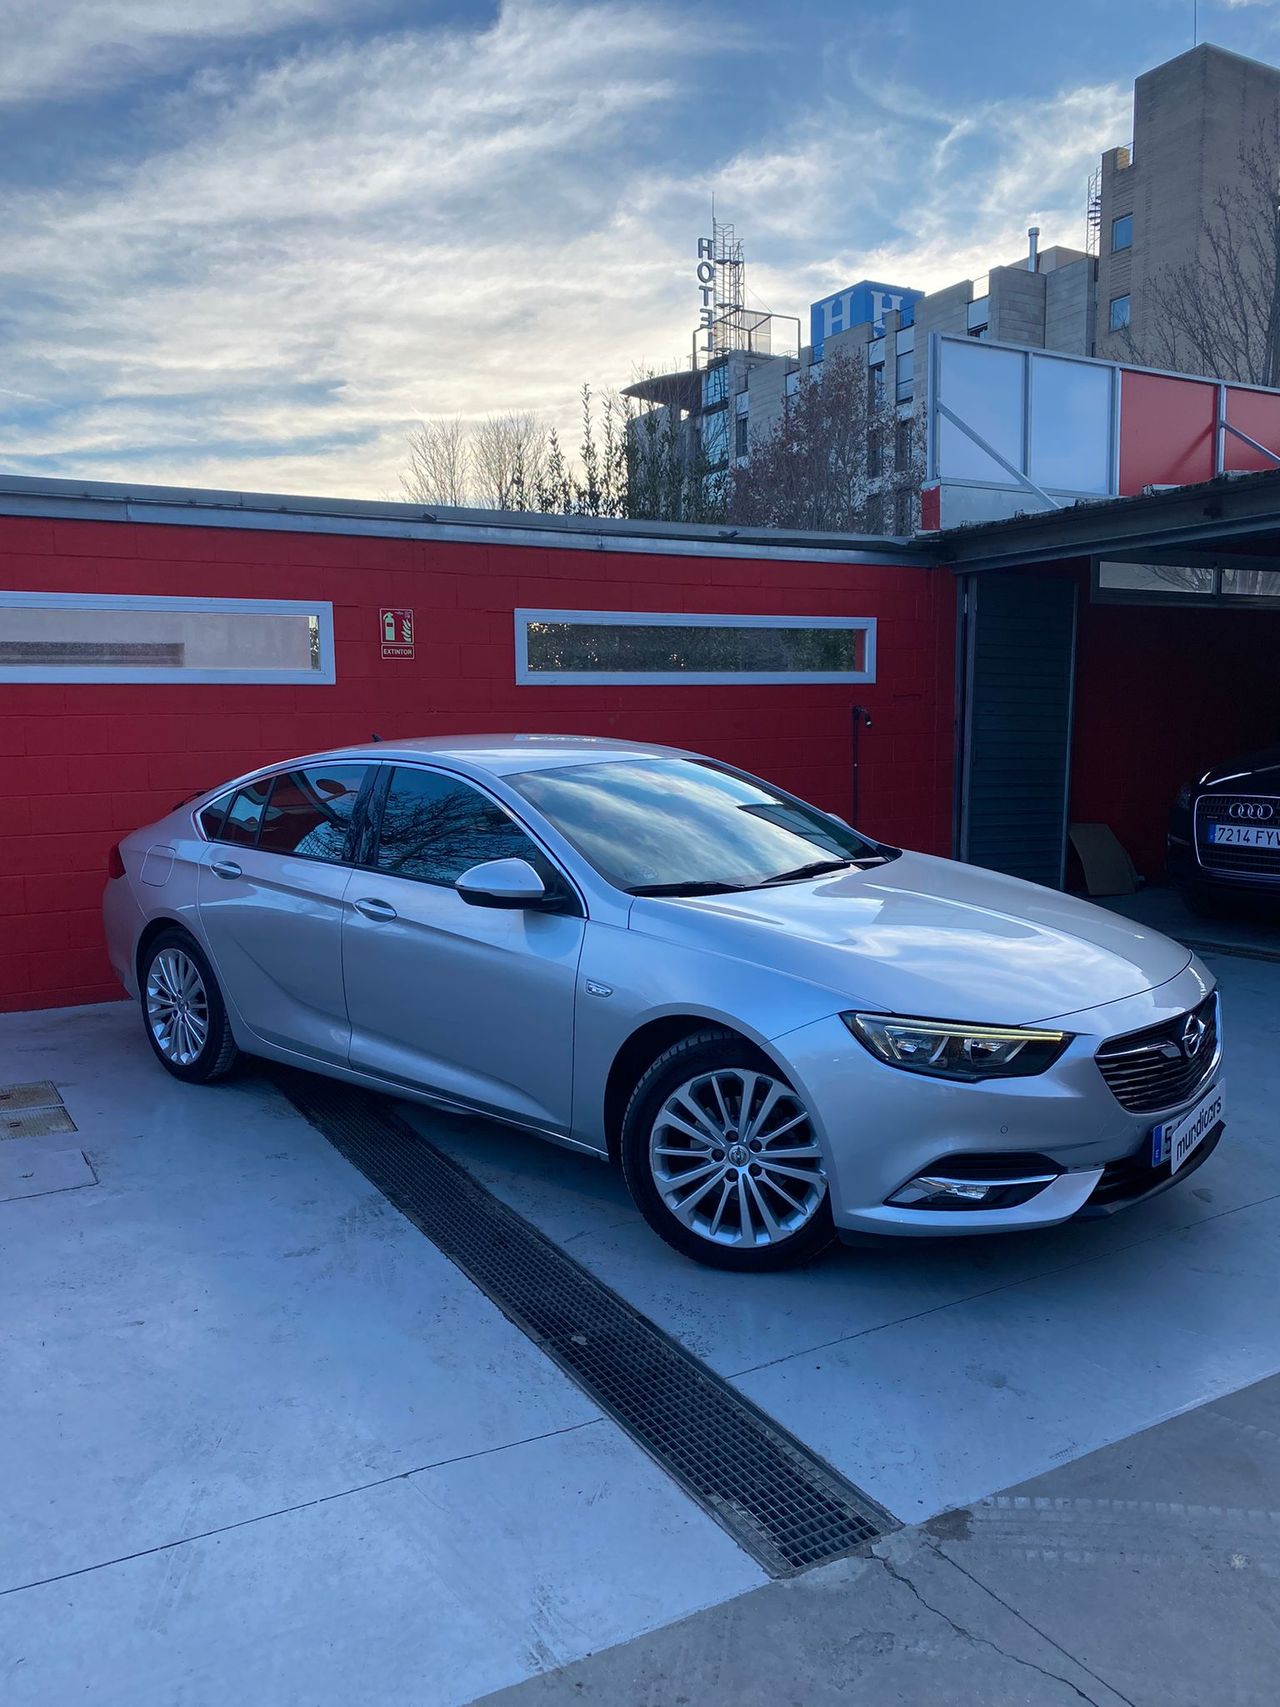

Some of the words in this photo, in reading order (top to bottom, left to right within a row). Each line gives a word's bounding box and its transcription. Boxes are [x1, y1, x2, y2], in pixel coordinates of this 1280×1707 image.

[822, 291, 854, 338] H
[1217, 827, 1251, 843] 7214
[1176, 1096, 1222, 1161] mundicars
